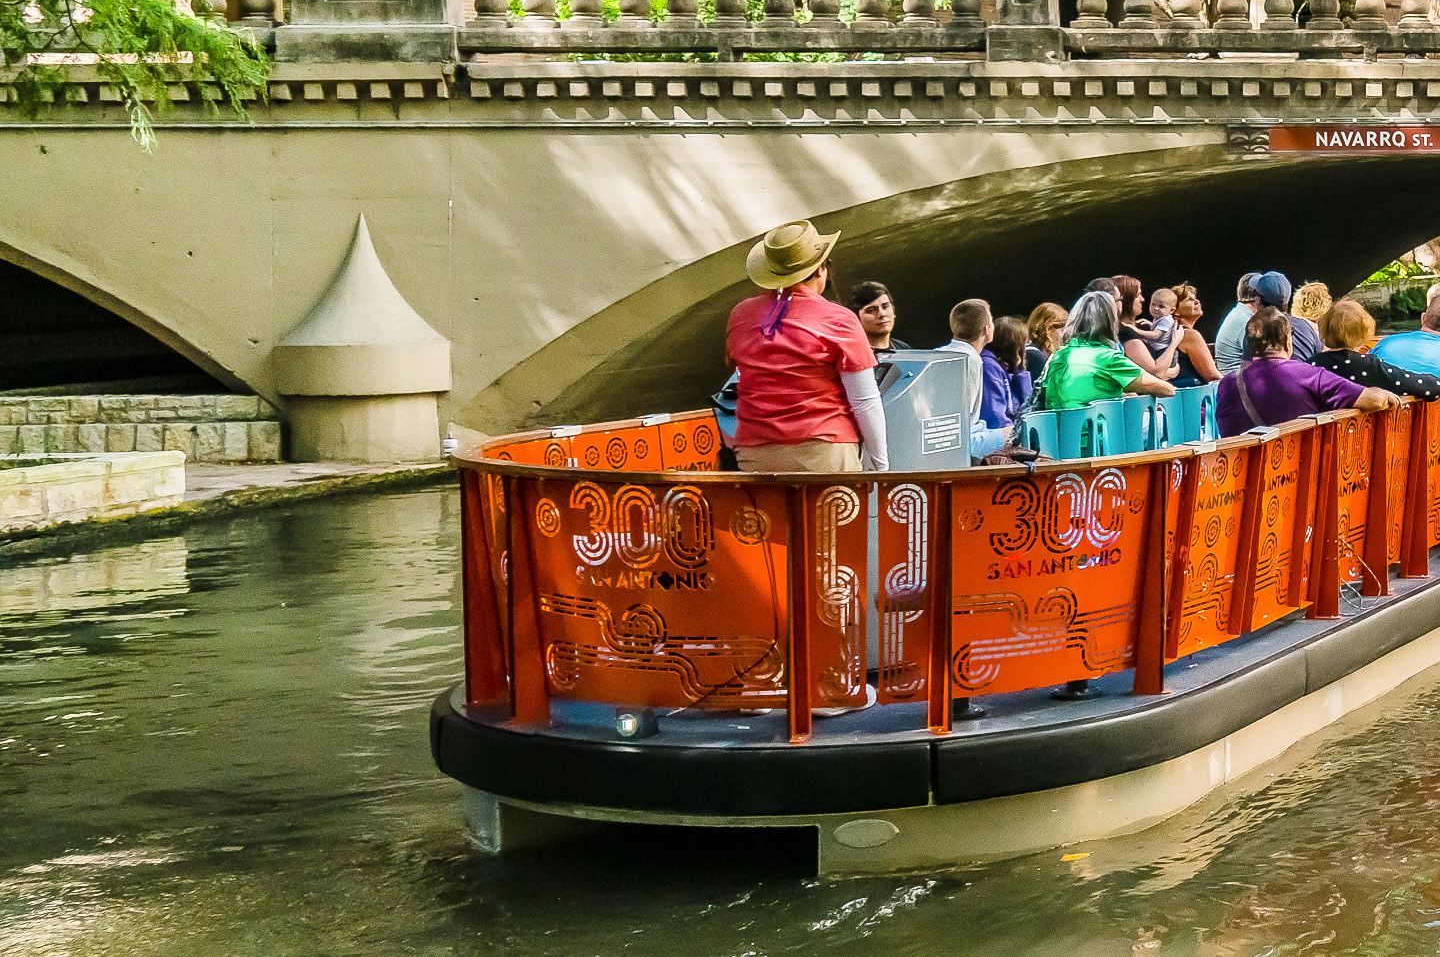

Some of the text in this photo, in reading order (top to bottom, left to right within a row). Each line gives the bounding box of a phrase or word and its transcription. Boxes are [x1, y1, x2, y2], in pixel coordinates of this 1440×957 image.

[1412, 133, 1434, 147] ST.
[569, 480, 715, 571] 300
[989, 467, 1127, 556] 300
[615, 569, 716, 591] ANTONIO
[987, 547, 1122, 581] SAN ANTONIO
